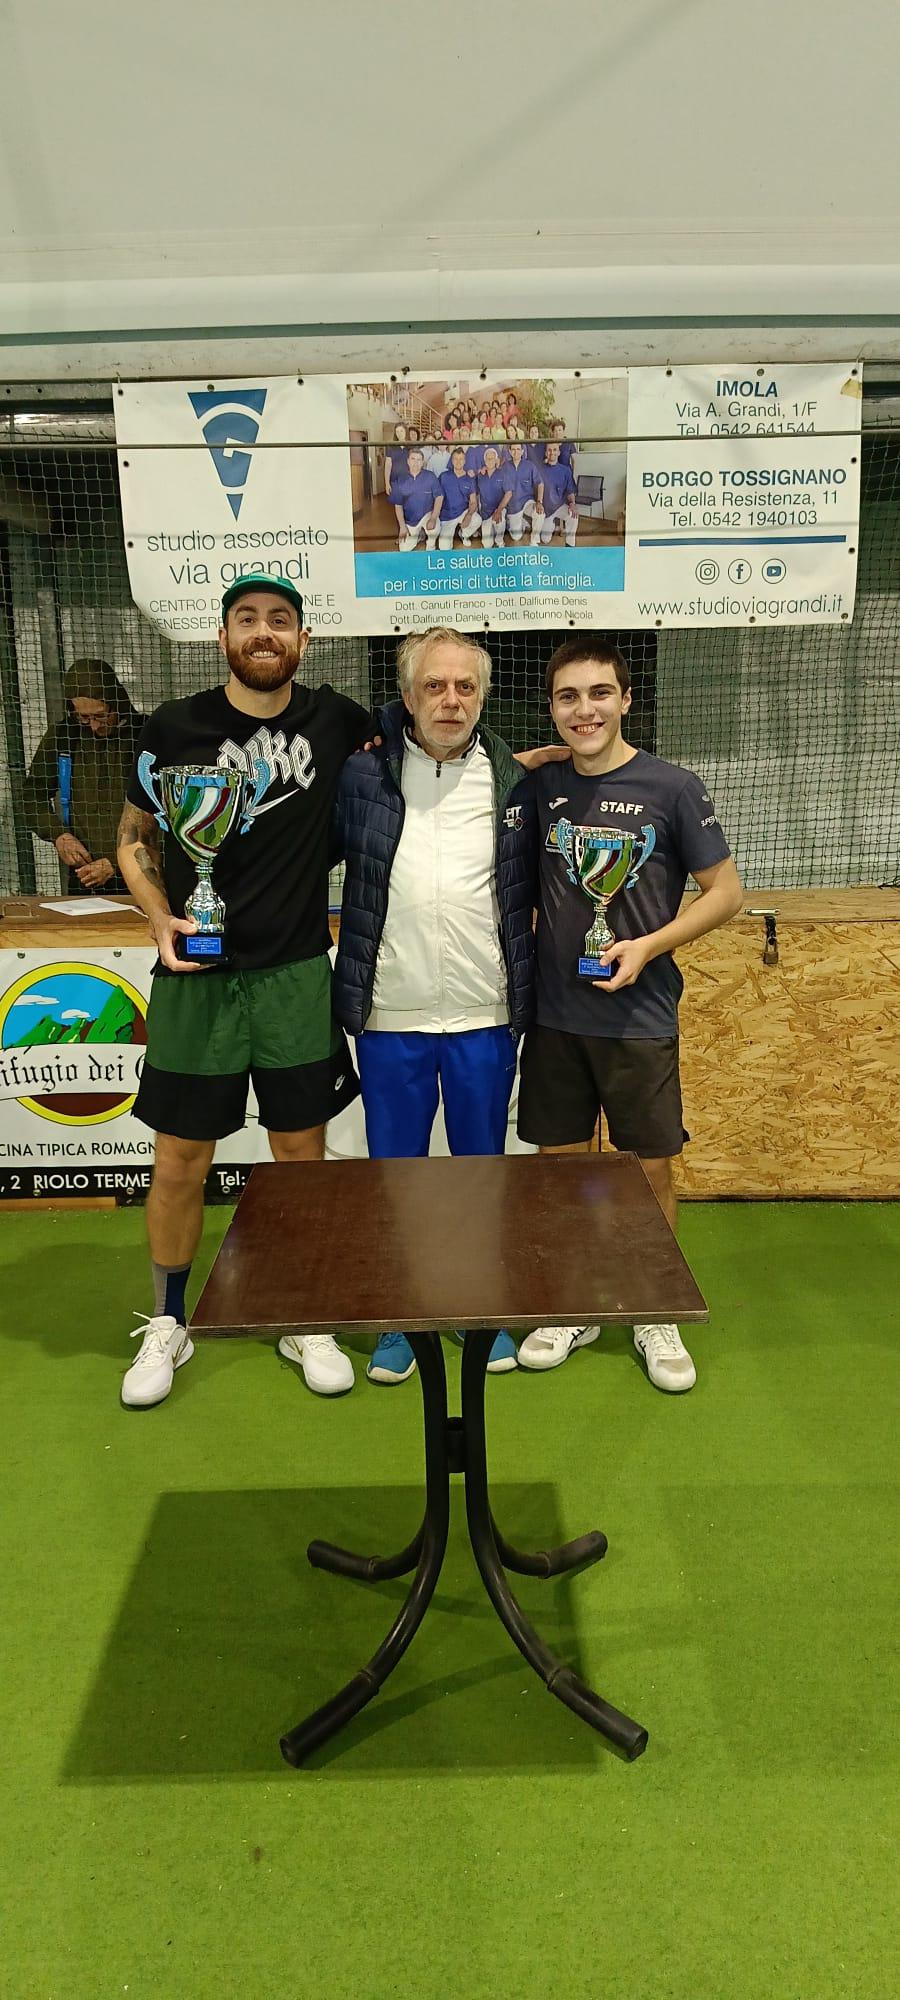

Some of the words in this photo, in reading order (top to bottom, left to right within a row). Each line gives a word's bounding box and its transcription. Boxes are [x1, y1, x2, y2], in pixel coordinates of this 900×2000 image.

[716, 380, 778, 397] IMOLA
[676, 402, 701, 418] Via
[705, 402, 721, 417] A.
[728, 401, 786, 419] Grandi,
[792, 401, 817, 417] 1/F
[677, 423, 701, 437] Tel
[710, 423, 751, 436] 0542
[756, 422, 816, 435] 641544
[642, 471, 713, 488] BORGO
[719, 468, 847, 487] TOSSIGNANO
[648, 493, 673, 508] Via
[679, 491, 716, 507] della
[722, 491, 816, 507] Resistenza,
[822, 490, 838, 505] 11
[669, 512, 697, 527] Tel.
[702, 511, 741, 526] 0542
[748, 510, 818, 526] 1940103
[147, 530, 216, 551] studio
[223, 525, 329, 550] associato
[427, 555, 445, 570] La
[450, 554, 493, 570] salute
[498, 552, 553, 569] dentale,
[169, 557, 211, 585] via
[384, 580, 407, 595] per
[412, 577, 416, 591] i
[420, 575, 463, 591] sorrisi
[468, 574, 480, 589] di
[484, 575, 517, 589] tutta
[521, 573, 533, 587] la
[537, 571, 596, 590] famiglia.
[149, 598, 207, 613] CENTRO
[395, 601, 417, 611] Dott.
[421, 600, 451, 610] Canuti
[453, 599, 486, 609] Franco
[495, 597, 516, 607] Dott.
[520, 596, 560, 606] Dalfiume
[561, 596, 588, 606] Denis
[637, 594, 843, 618] www.studioviagrandi.it
[455, 612, 490, 622] Daniele
[498, 611, 520, 621] Dott.
[523, 610, 563, 620] Rotunno
[564, 609, 593, 619] Nicola
[506, 805, 522, 819] FIT
[600, 801, 644, 815] STAFF
[0, 1054, 78, 1092] ifugio
[88, 1054, 124, 1081] dei
[36, 1143, 87, 1157] TIPICA
[91, 1141, 156, 1156] ROMAGN
[10, 1175, 21, 1190] 2
[33, 1173, 89, 1190] RIOLO
[93, 1172, 151, 1188] TERME
[216, 1170, 246, 1186] Tel:
